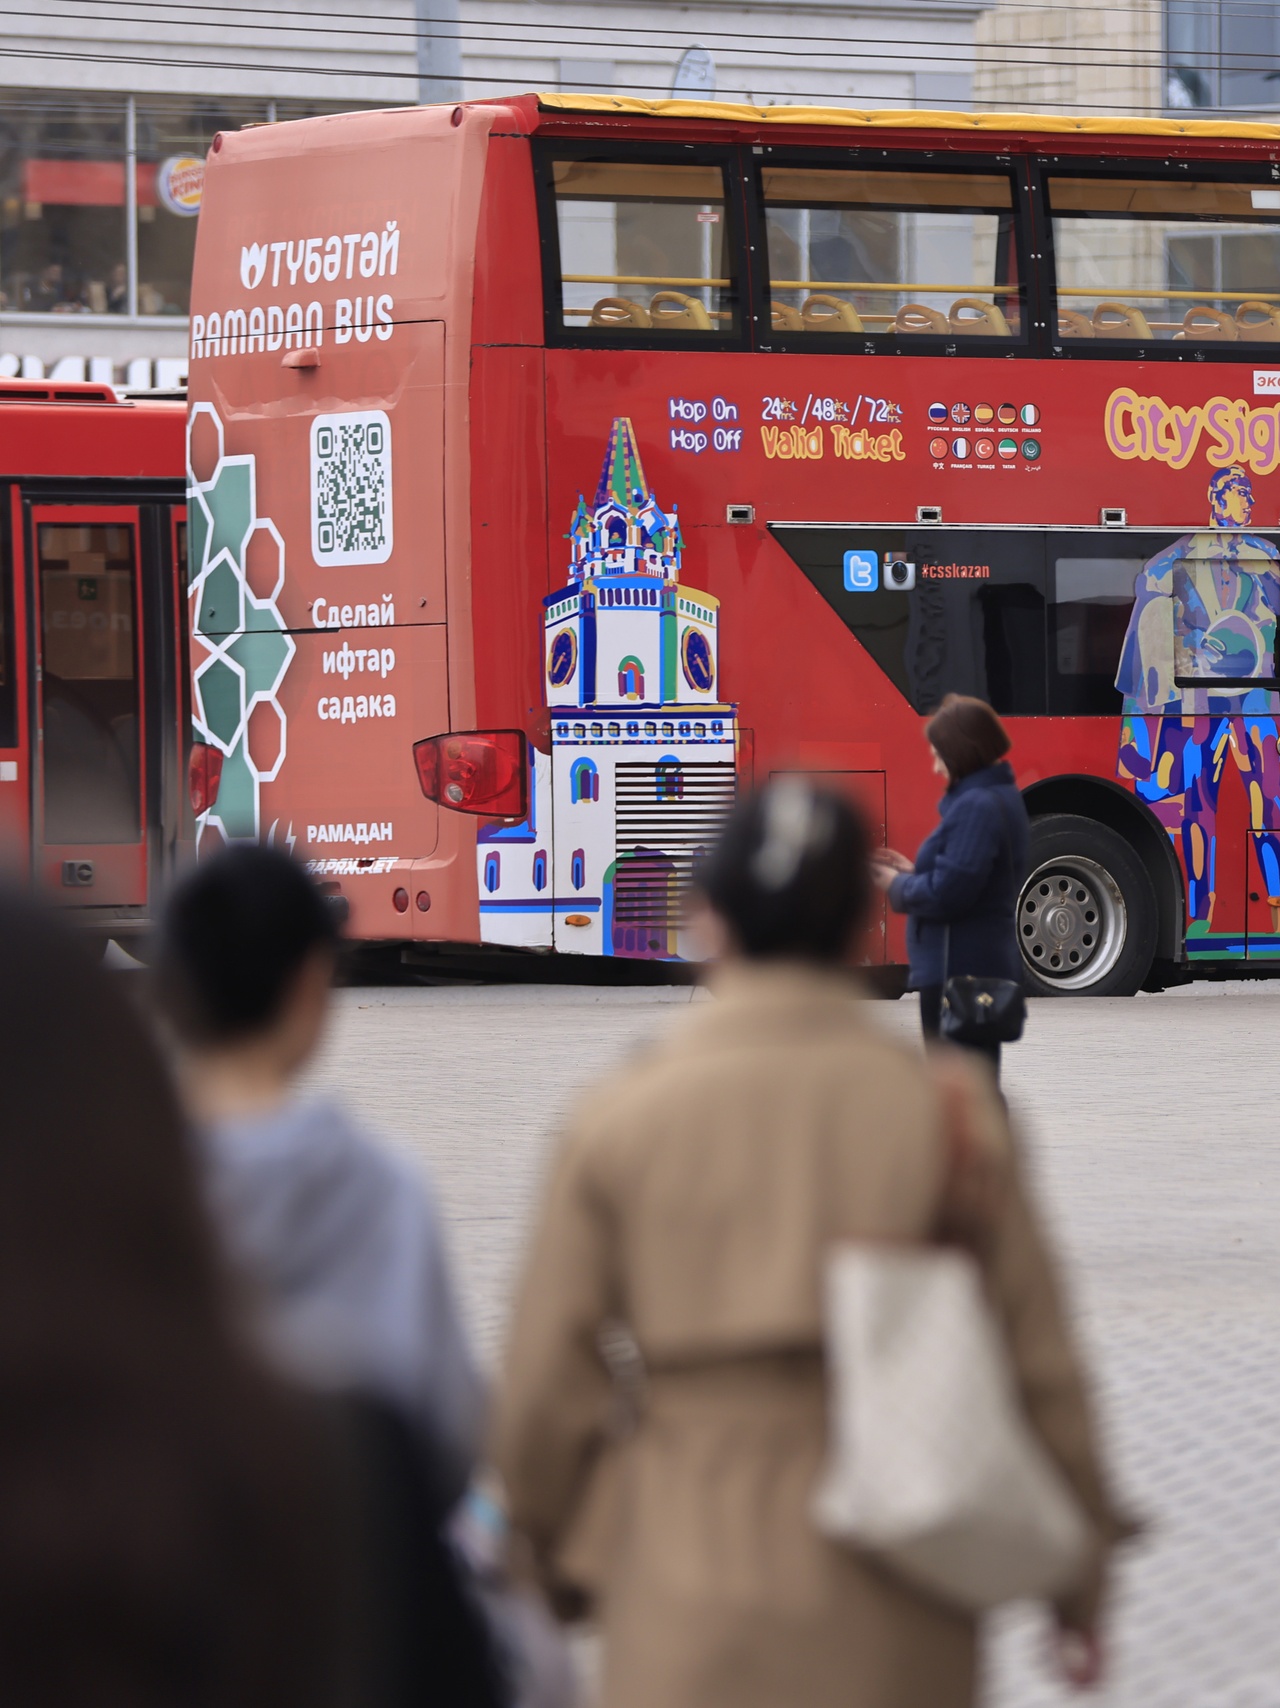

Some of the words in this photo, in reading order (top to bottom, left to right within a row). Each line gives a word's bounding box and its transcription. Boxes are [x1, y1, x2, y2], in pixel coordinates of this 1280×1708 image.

[172, 178, 205, 198] KIN
[191, 301, 323, 360] RAMADAN
[335, 294, 394, 345] BUS
[669, 398, 707, 424] Hop
[712, 397, 738, 421] On
[670, 428, 708, 453] Hop
[713, 427, 743, 451] Off
[760, 425, 824, 460] Valid
[830, 424, 906, 463] Ticket
[921, 563, 990, 579] #csskazan
[312, 593, 395, 629] Сделай
[322, 641, 395, 680] ифтар
[318, 694, 396, 724] садака
[307, 822, 393, 845] РАМАДАН
